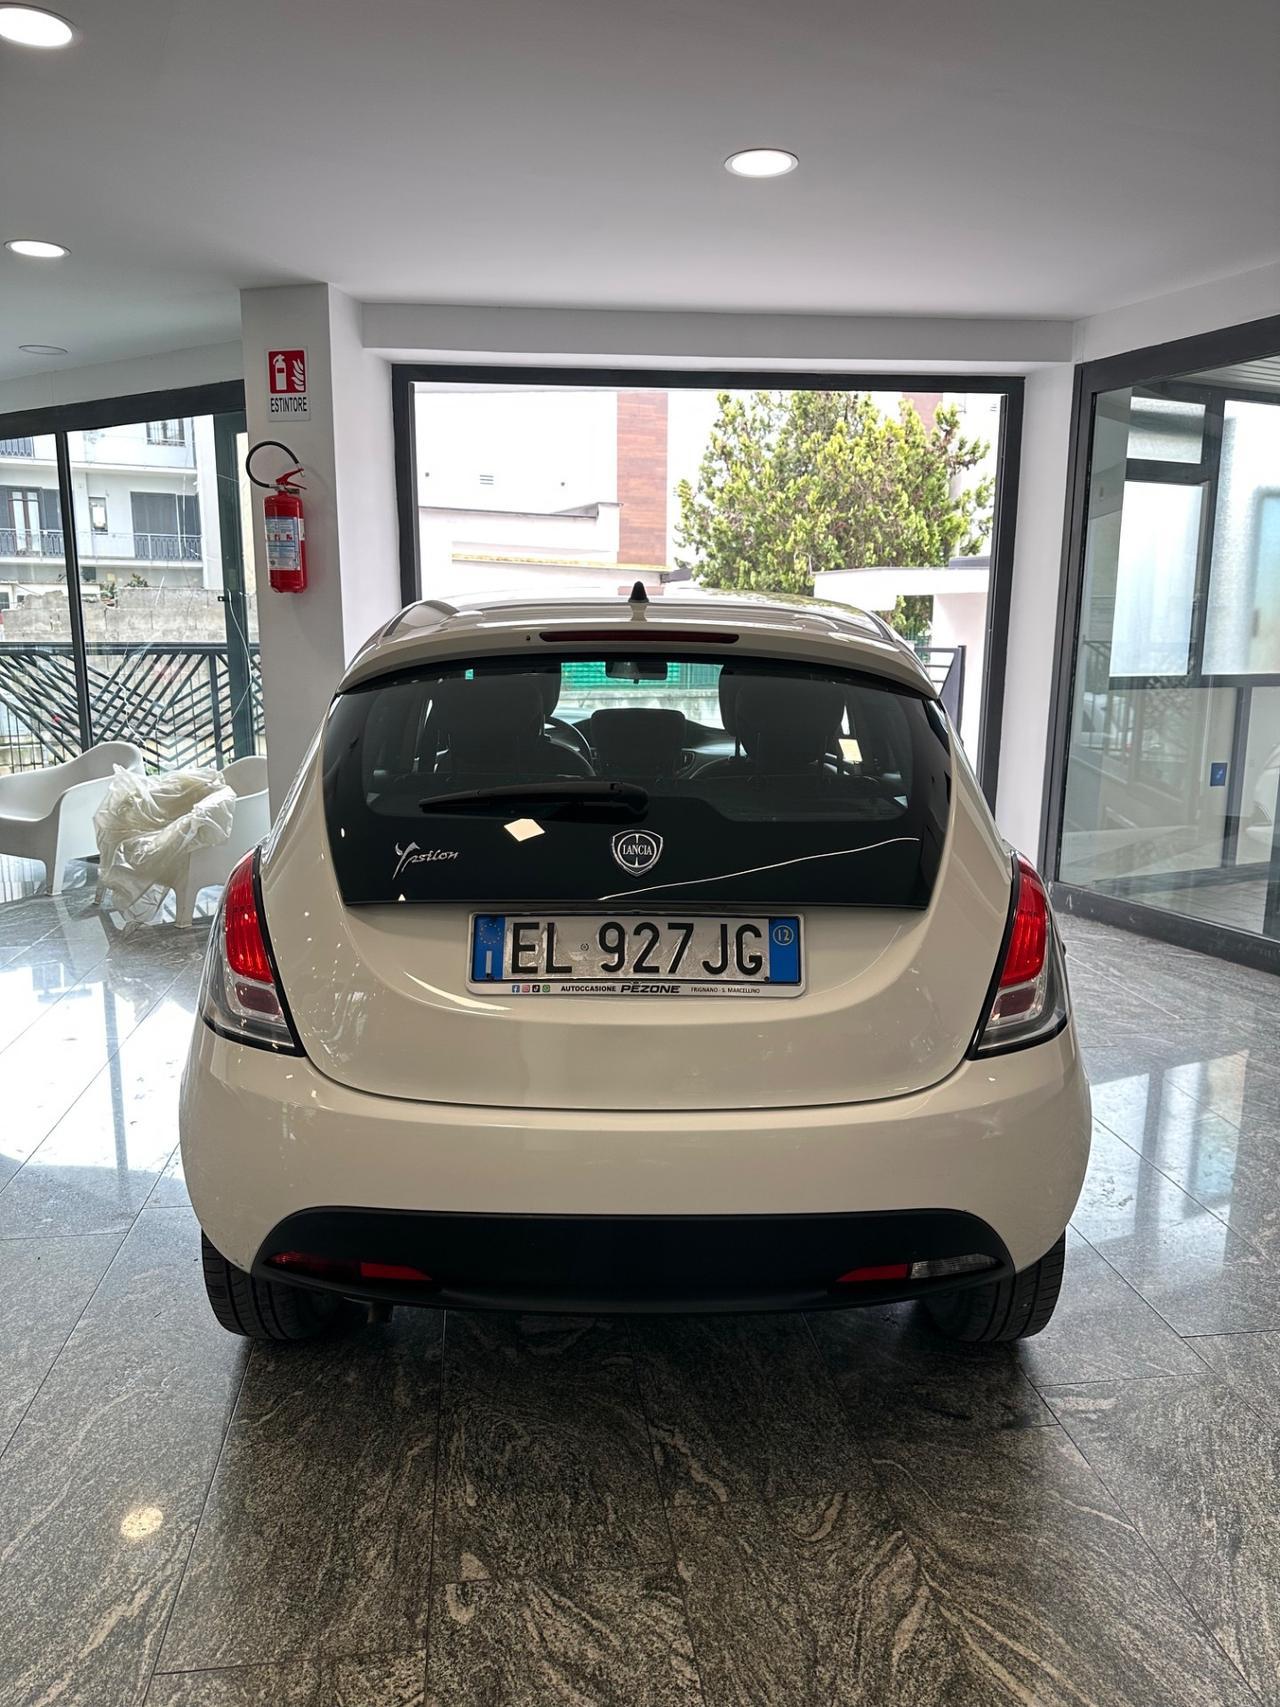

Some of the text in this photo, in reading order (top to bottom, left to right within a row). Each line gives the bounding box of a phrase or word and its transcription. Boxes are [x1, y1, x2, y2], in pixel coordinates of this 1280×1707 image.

[270, 396, 308, 412] ESTINTORE
[622, 844, 652, 856] LANCIA
[392, 842, 459, 880] Ypsilon
[777, 929, 790, 941] 12
[511, 921, 763, 975] EL 927 JG
[560, 984, 617, 993] AUTOCCASIONE
